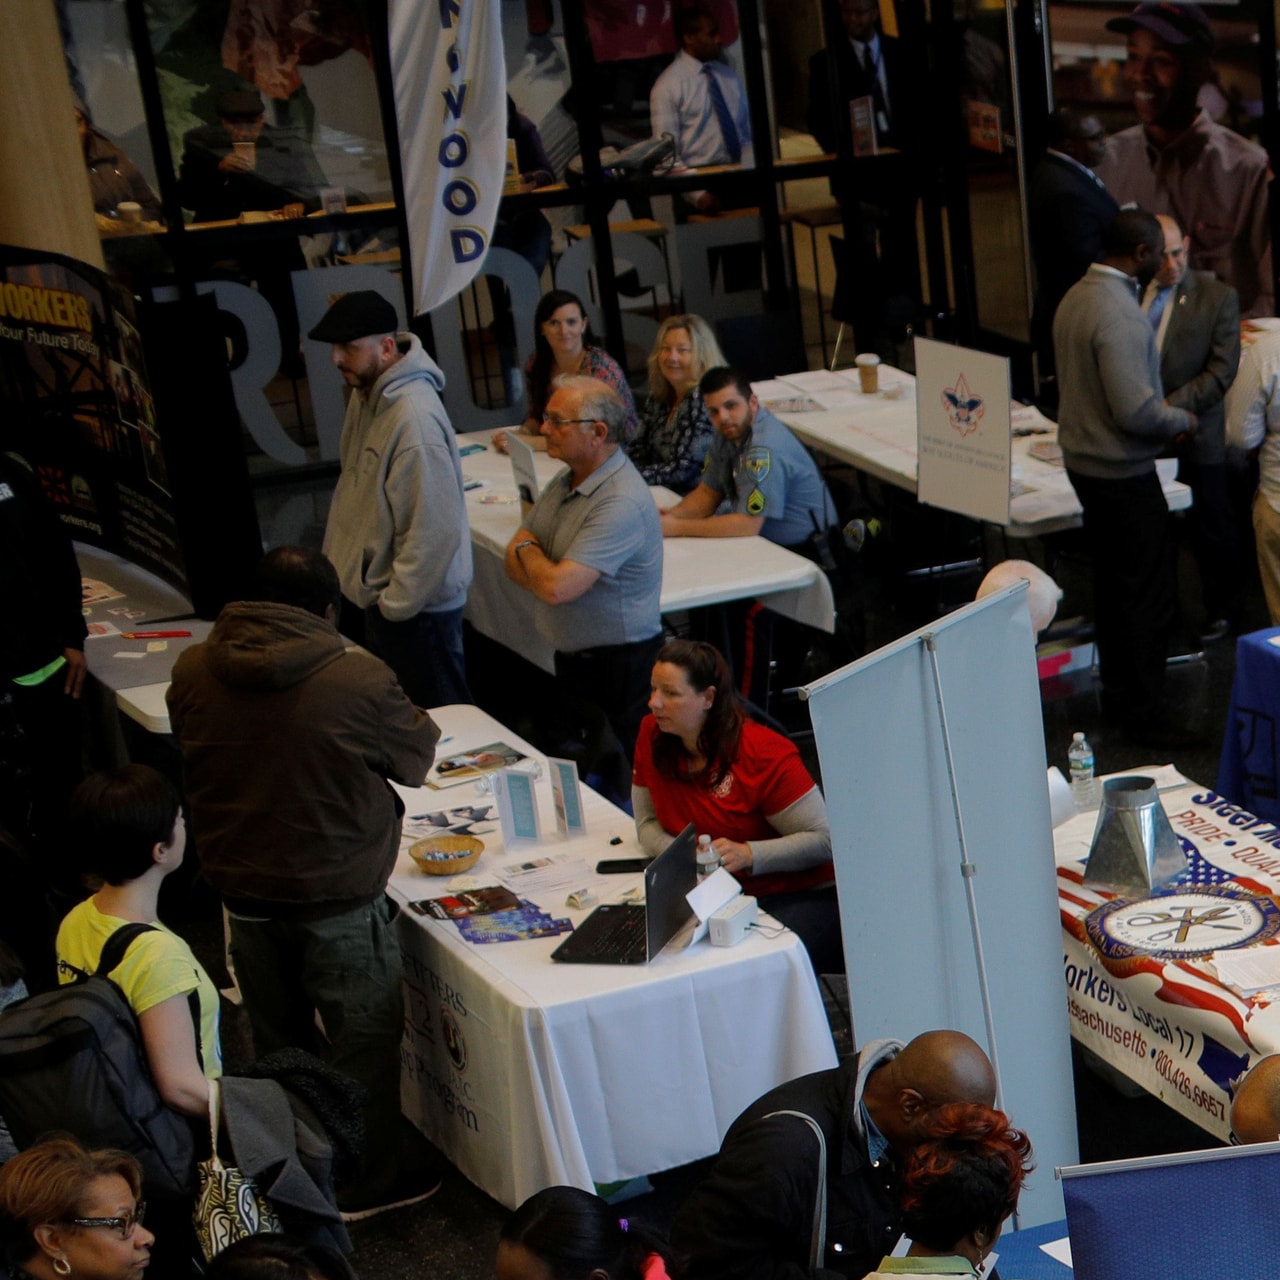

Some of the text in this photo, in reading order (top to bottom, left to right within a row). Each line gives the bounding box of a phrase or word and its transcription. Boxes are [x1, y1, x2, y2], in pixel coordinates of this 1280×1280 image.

[0, 281, 93, 334] ORKERS
[26, 327, 69, 350] Future
[70, 334, 100, 361] Today
[1173, 810, 1230, 843] PRIDE
[1064, 956, 1195, 1059] orkers Local 17
[1067, 999, 1148, 1059] ssachusetts
